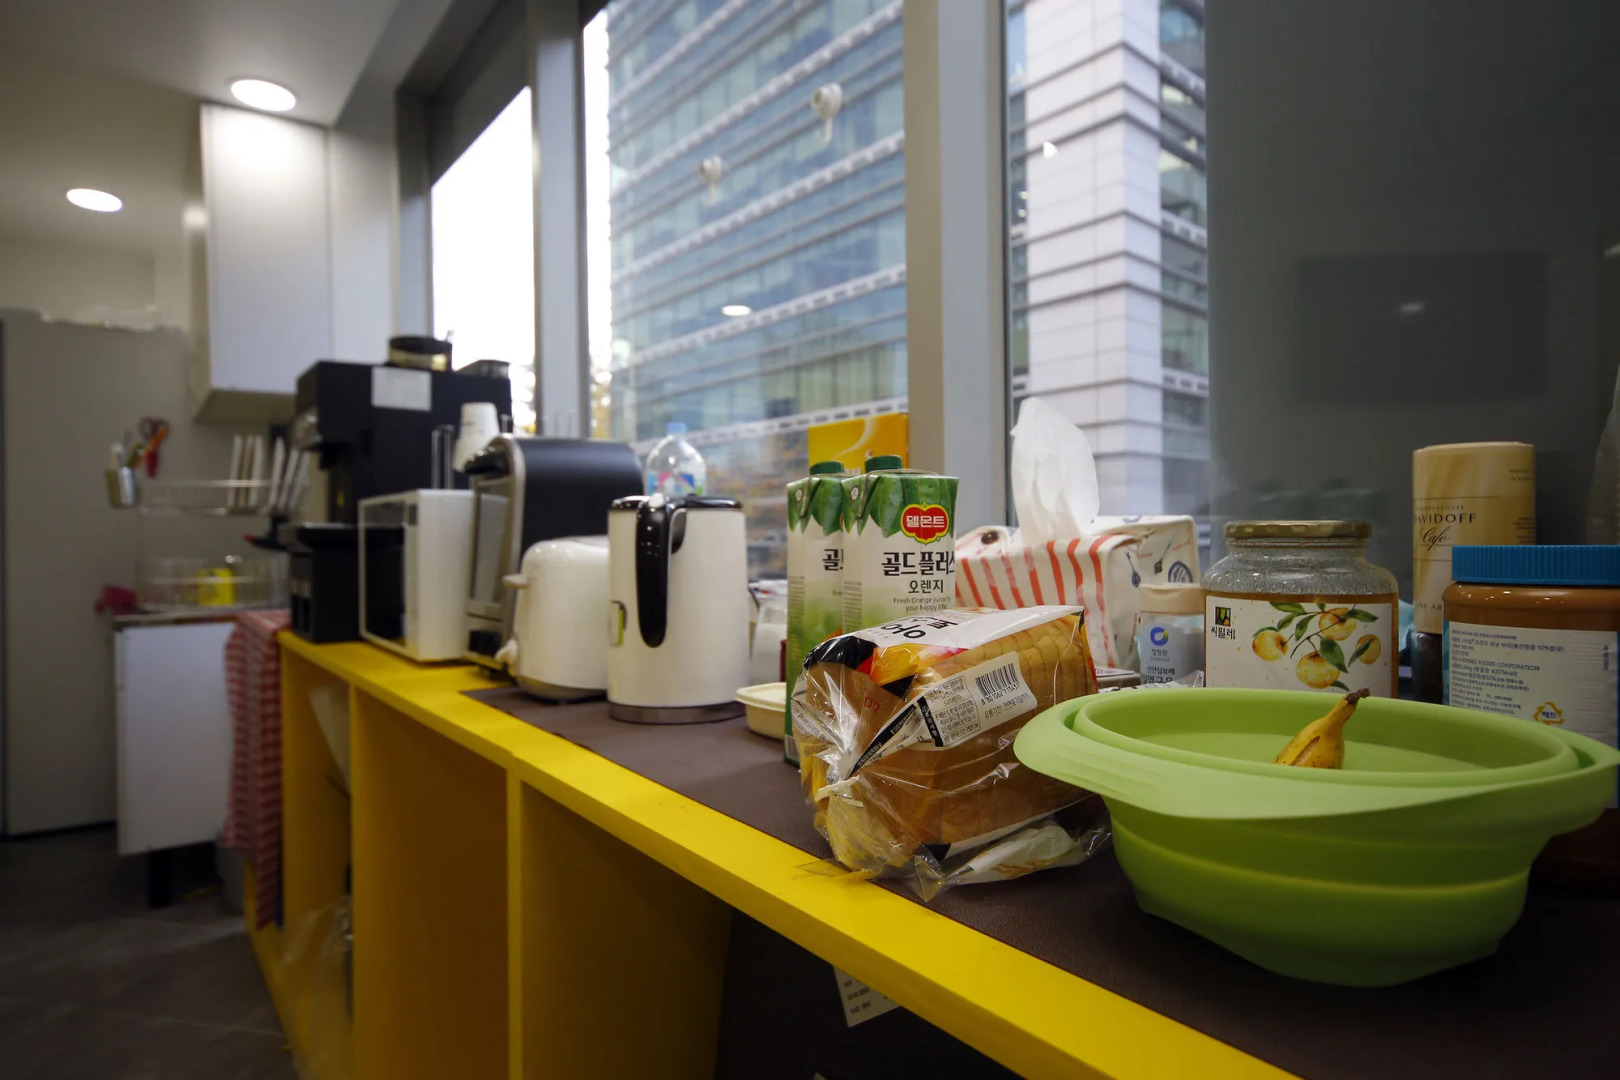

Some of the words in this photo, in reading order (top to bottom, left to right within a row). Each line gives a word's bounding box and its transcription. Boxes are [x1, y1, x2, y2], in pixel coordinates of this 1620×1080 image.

[906, 515, 945, 528] 델몬트
[1414, 513, 1477, 524] AVIDOFF
[908, 579, 944, 594] 오렌지
[911, 597, 933, 605] Orange
[906, 604, 919, 613] your
[1211, 626, 1236, 640] 씨밀레
